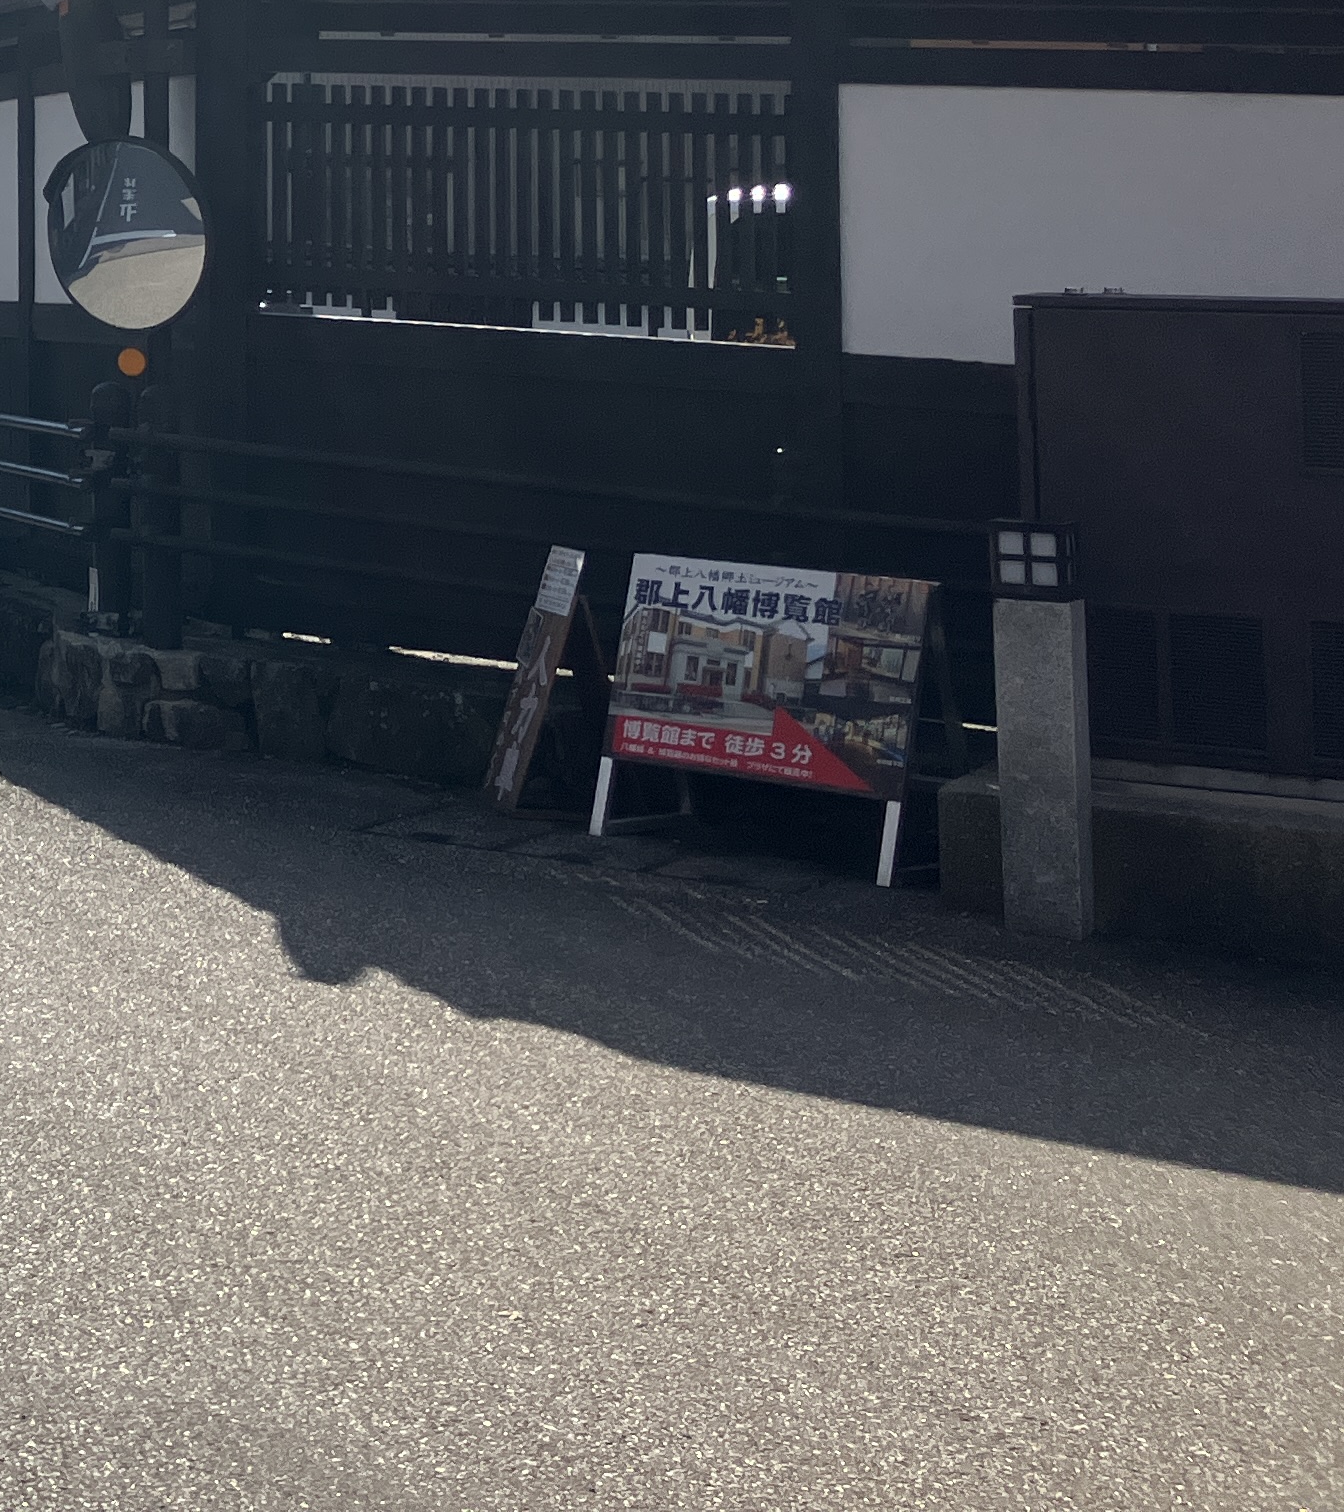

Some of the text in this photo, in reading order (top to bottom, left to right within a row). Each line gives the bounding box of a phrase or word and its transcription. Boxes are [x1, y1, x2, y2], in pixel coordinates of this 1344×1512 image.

[633, 578, 844, 627] 郡上八幡博覧館
[622, 719, 716, 750] 博覧館まで
